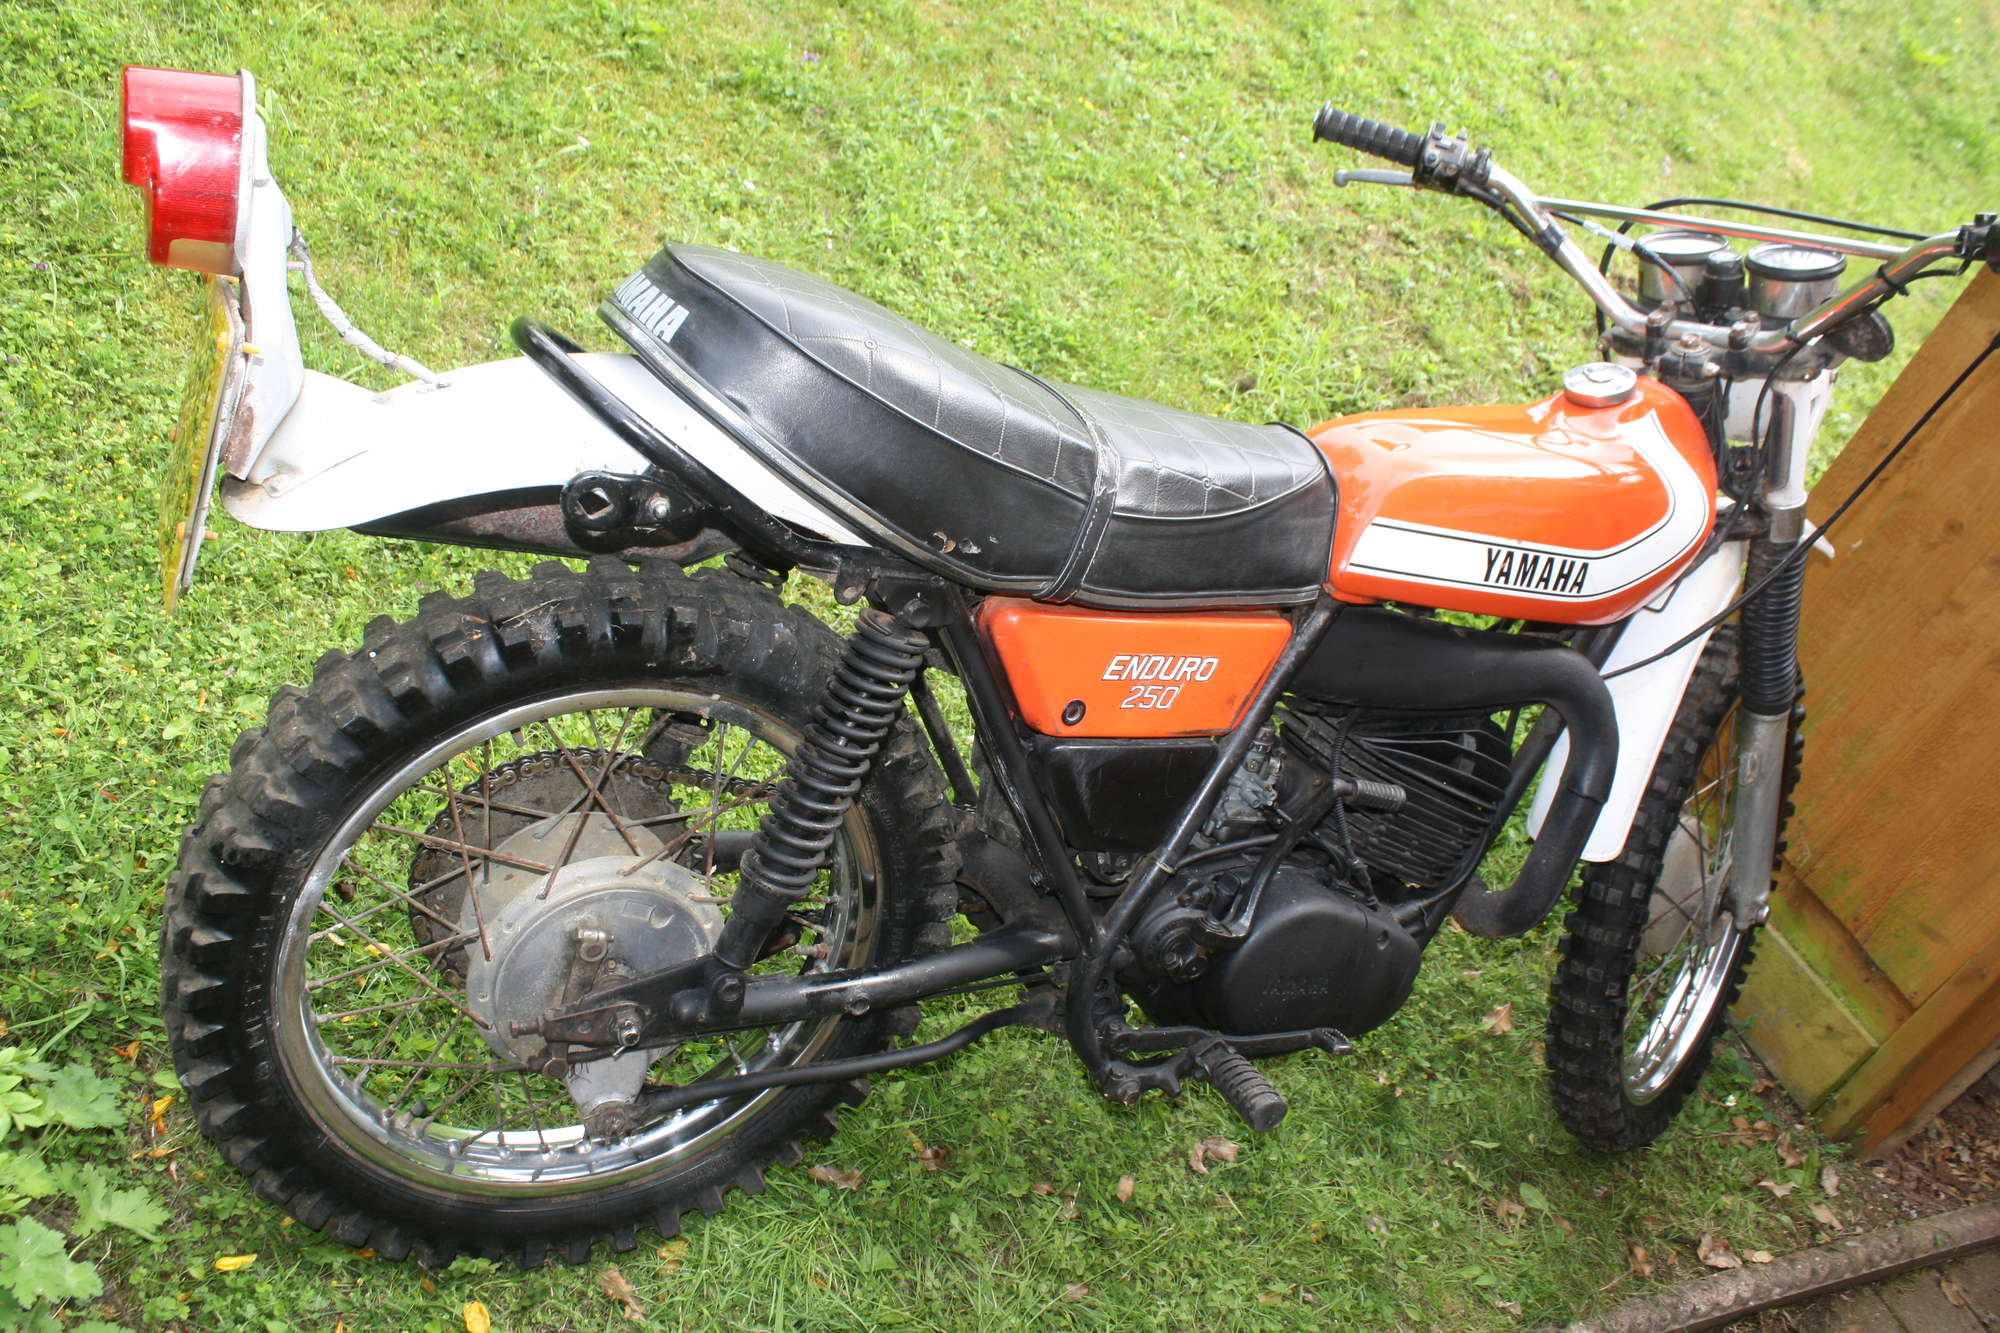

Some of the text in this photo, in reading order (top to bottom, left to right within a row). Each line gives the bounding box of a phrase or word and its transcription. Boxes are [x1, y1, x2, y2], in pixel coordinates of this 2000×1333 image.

[614, 269, 690, 344] AMAHA
[1483, 547, 1589, 595] YAMAHA
[1101, 653, 1219, 681] ENDURO
[1120, 685, 1180, 709] 250
